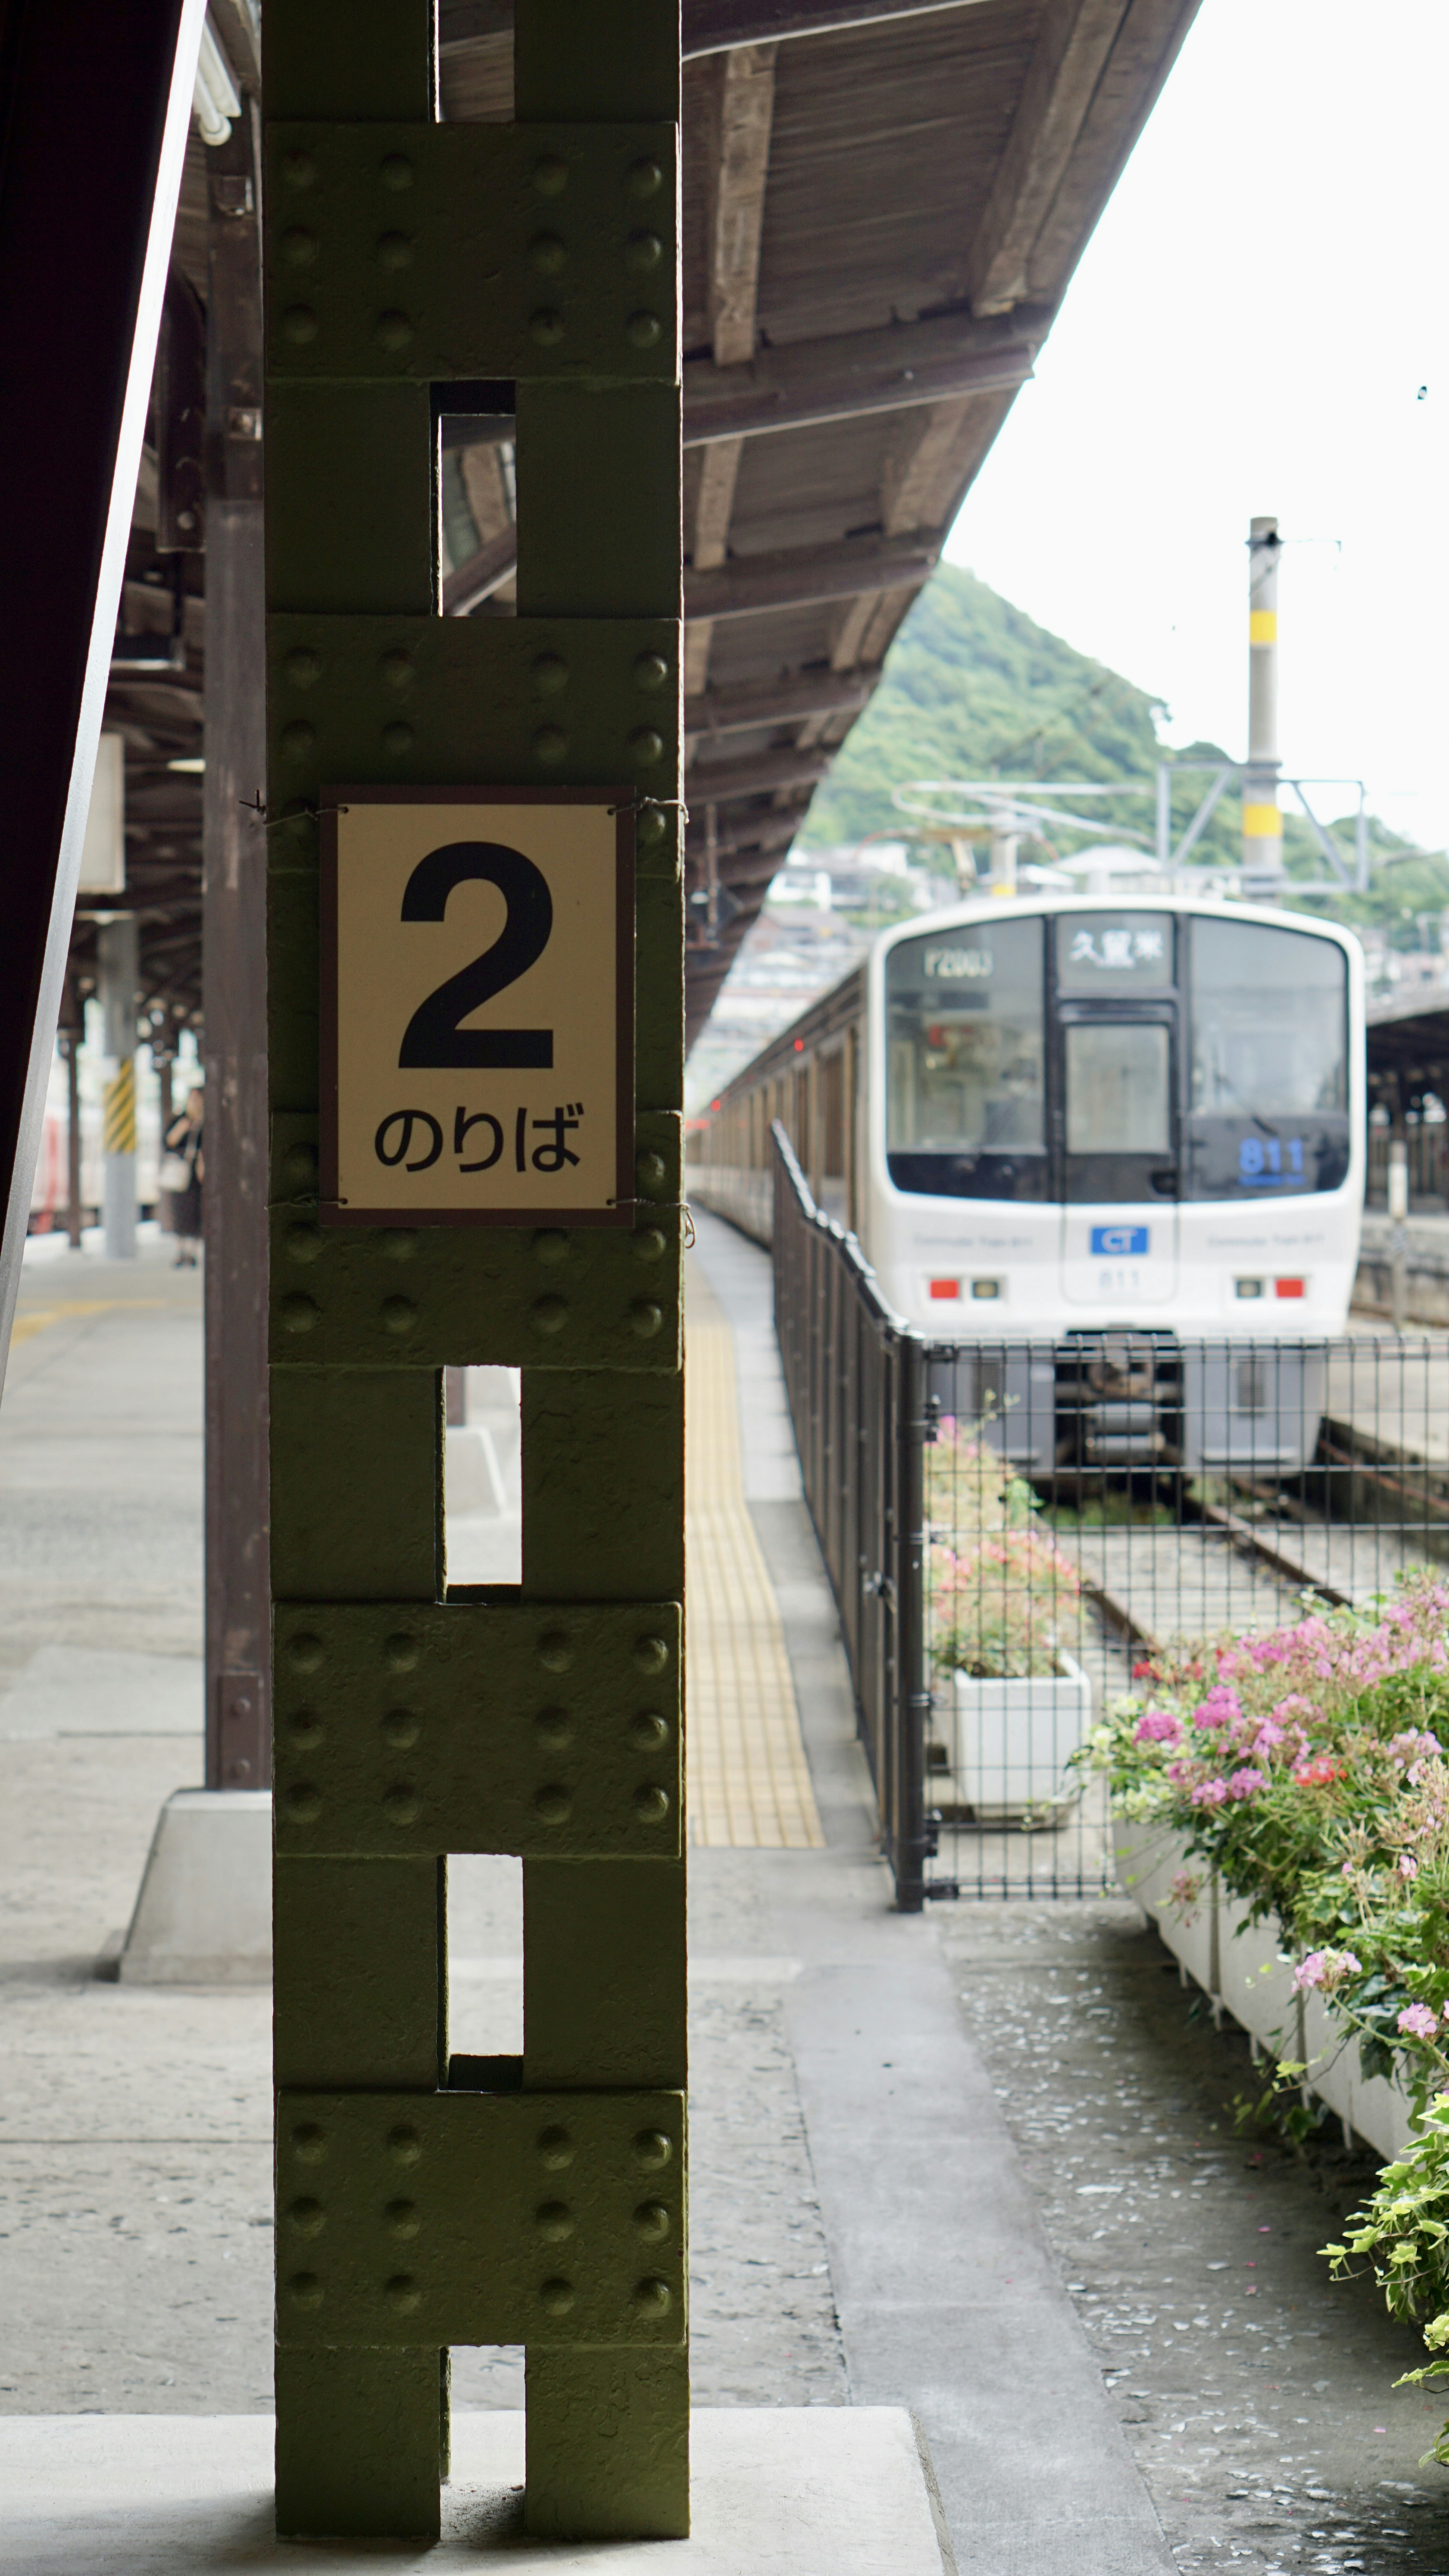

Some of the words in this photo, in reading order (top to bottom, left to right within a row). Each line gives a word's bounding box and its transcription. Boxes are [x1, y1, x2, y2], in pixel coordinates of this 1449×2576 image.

[398, 841, 553, 1068] 2
[1069, 929, 1163, 963] 久留米
[374, 1102, 584, 1173] のりば
[1239, 1138, 1303, 1173] 811
[1102, 1229, 1137, 1252] CT
[1099, 1269, 1139, 1288] 811
